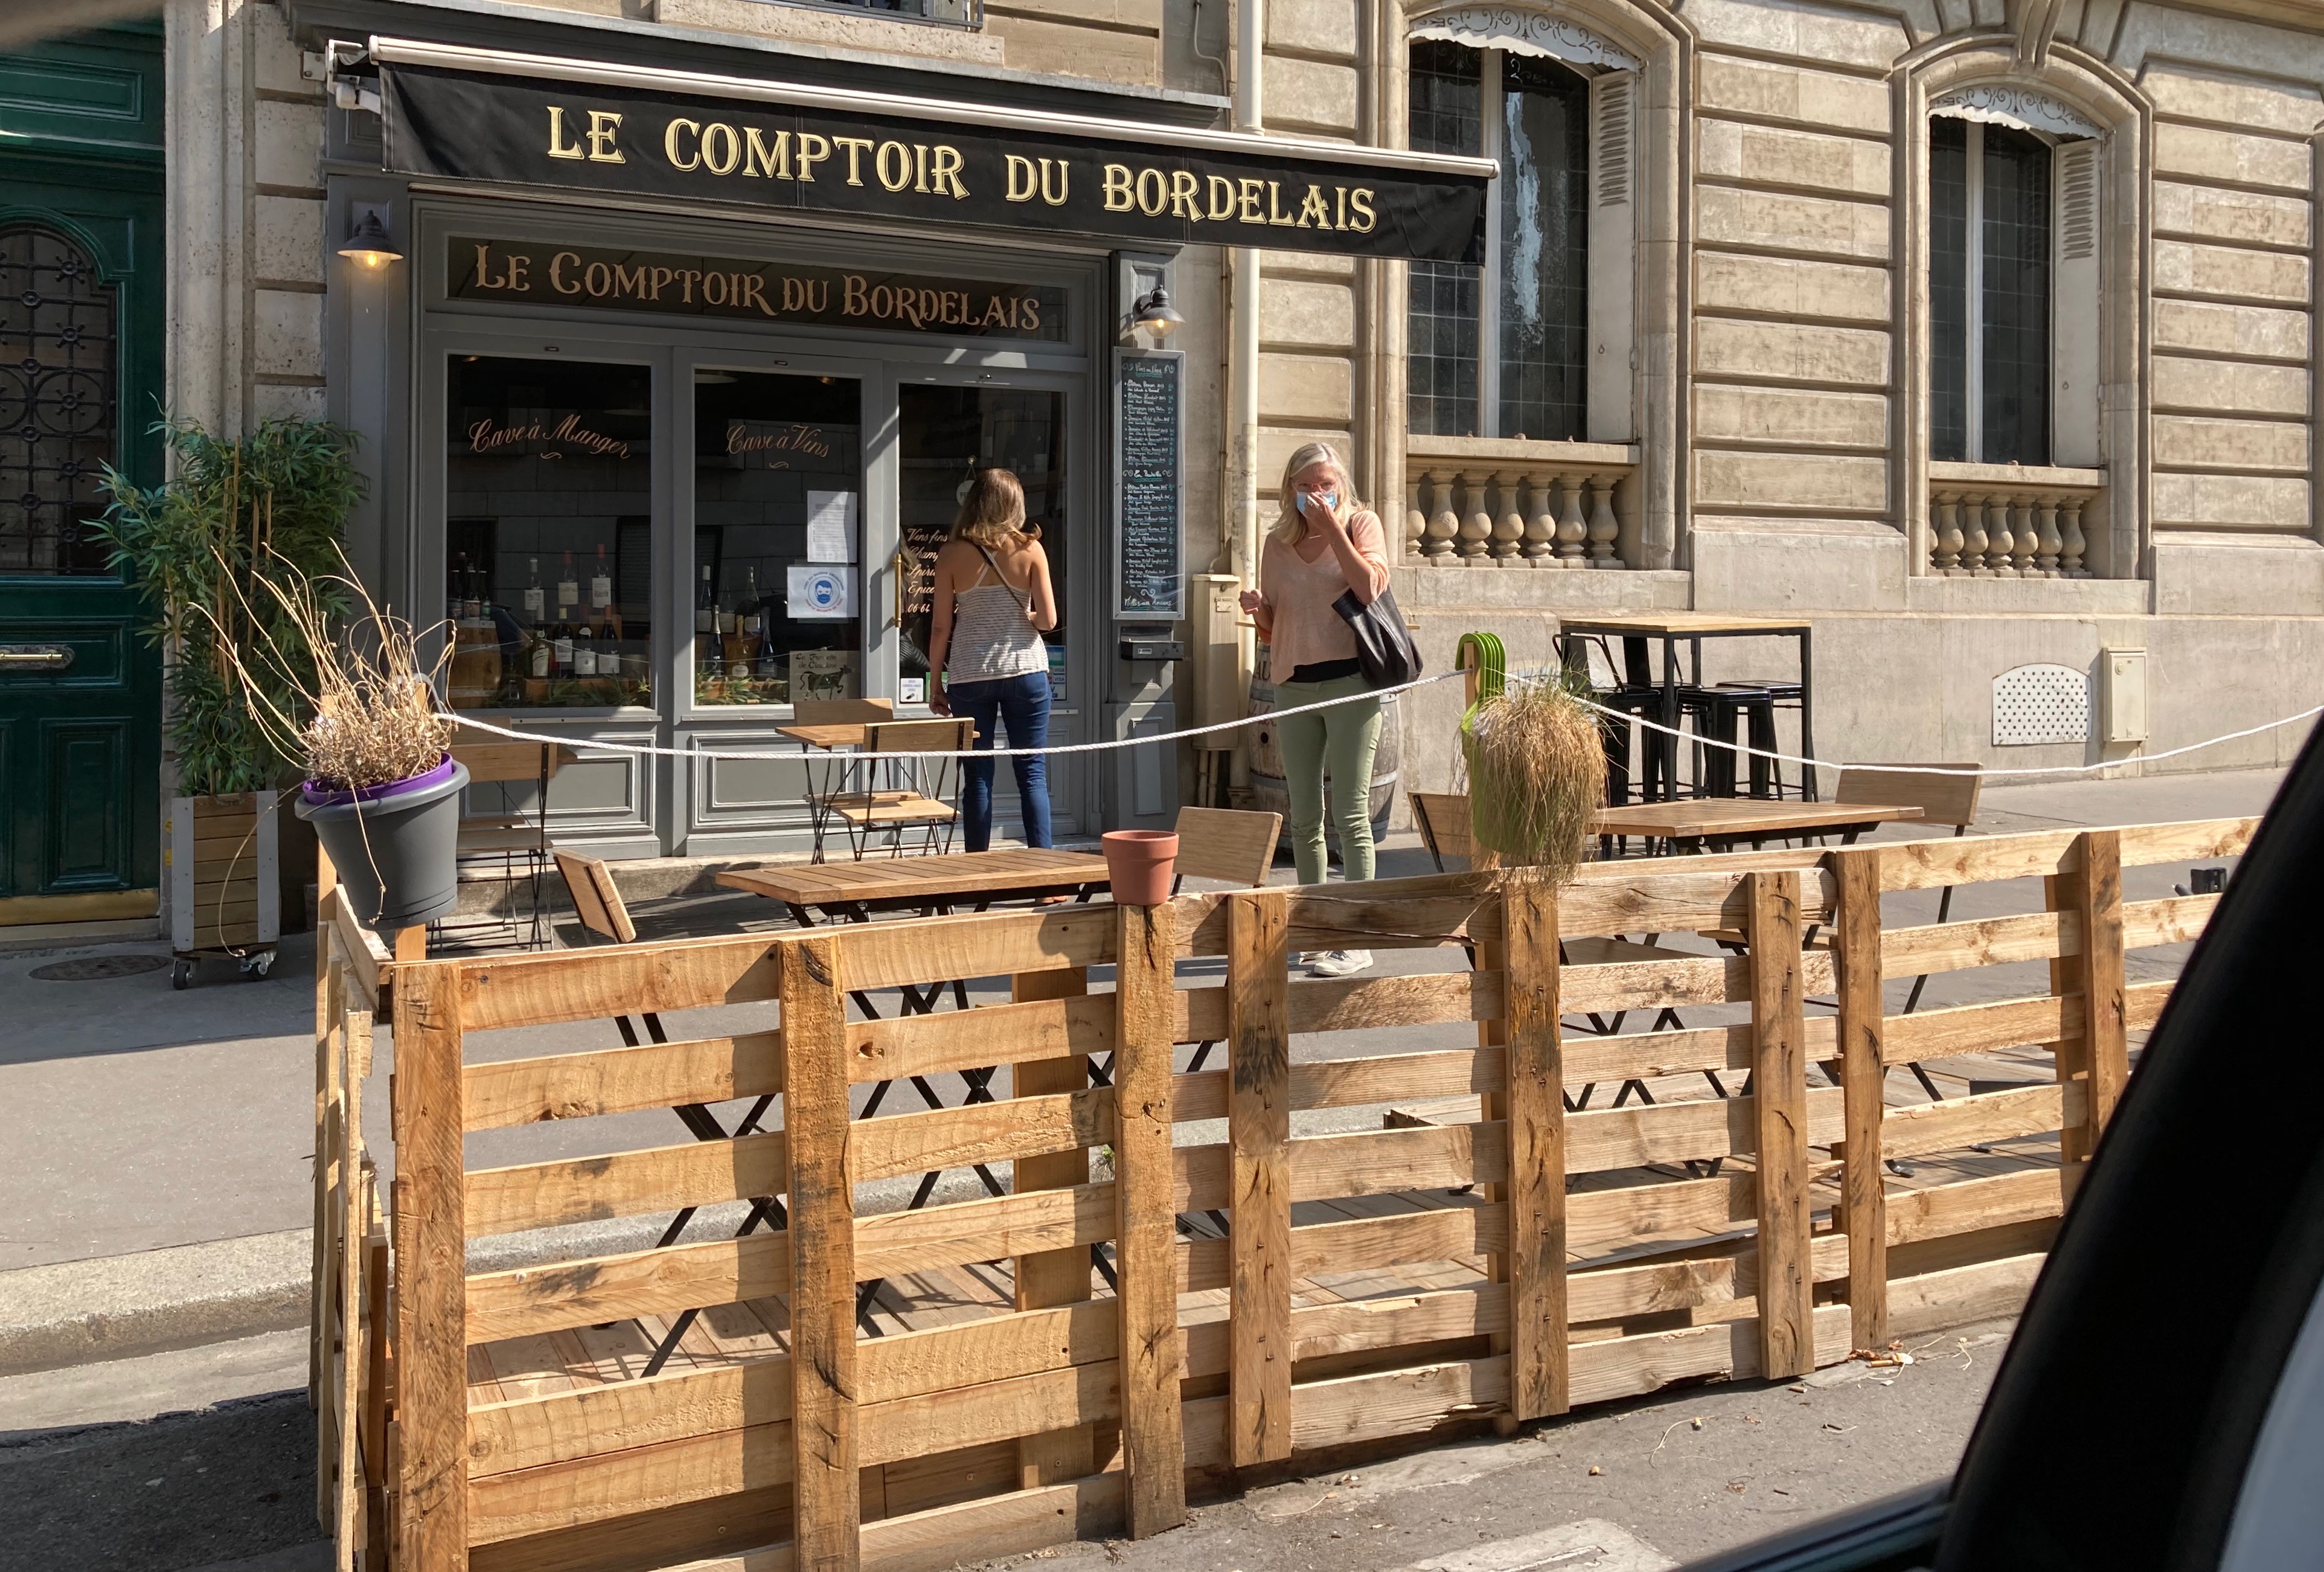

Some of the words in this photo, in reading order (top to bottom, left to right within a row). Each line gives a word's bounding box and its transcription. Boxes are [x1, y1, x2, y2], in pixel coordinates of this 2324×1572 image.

[546, 106, 626, 164] LE
[664, 118, 970, 200] COMPTOIR
[1005, 154, 1069, 206] DU
[1101, 164, 1377, 234] BORDELAIS
[782, 277, 830, 313] DU
[469, 418, 525, 452] Cave
[525, 417, 540, 440] à
[542, 414, 631, 459] Manger
[726, 425, 773, 455] Cave
[776, 428, 789, 449] à
[790, 425, 830, 458] Vins
[907, 528, 929, 542] Vins
[928, 530, 948, 544] fins
[907, 563, 935, 579] Spiri
